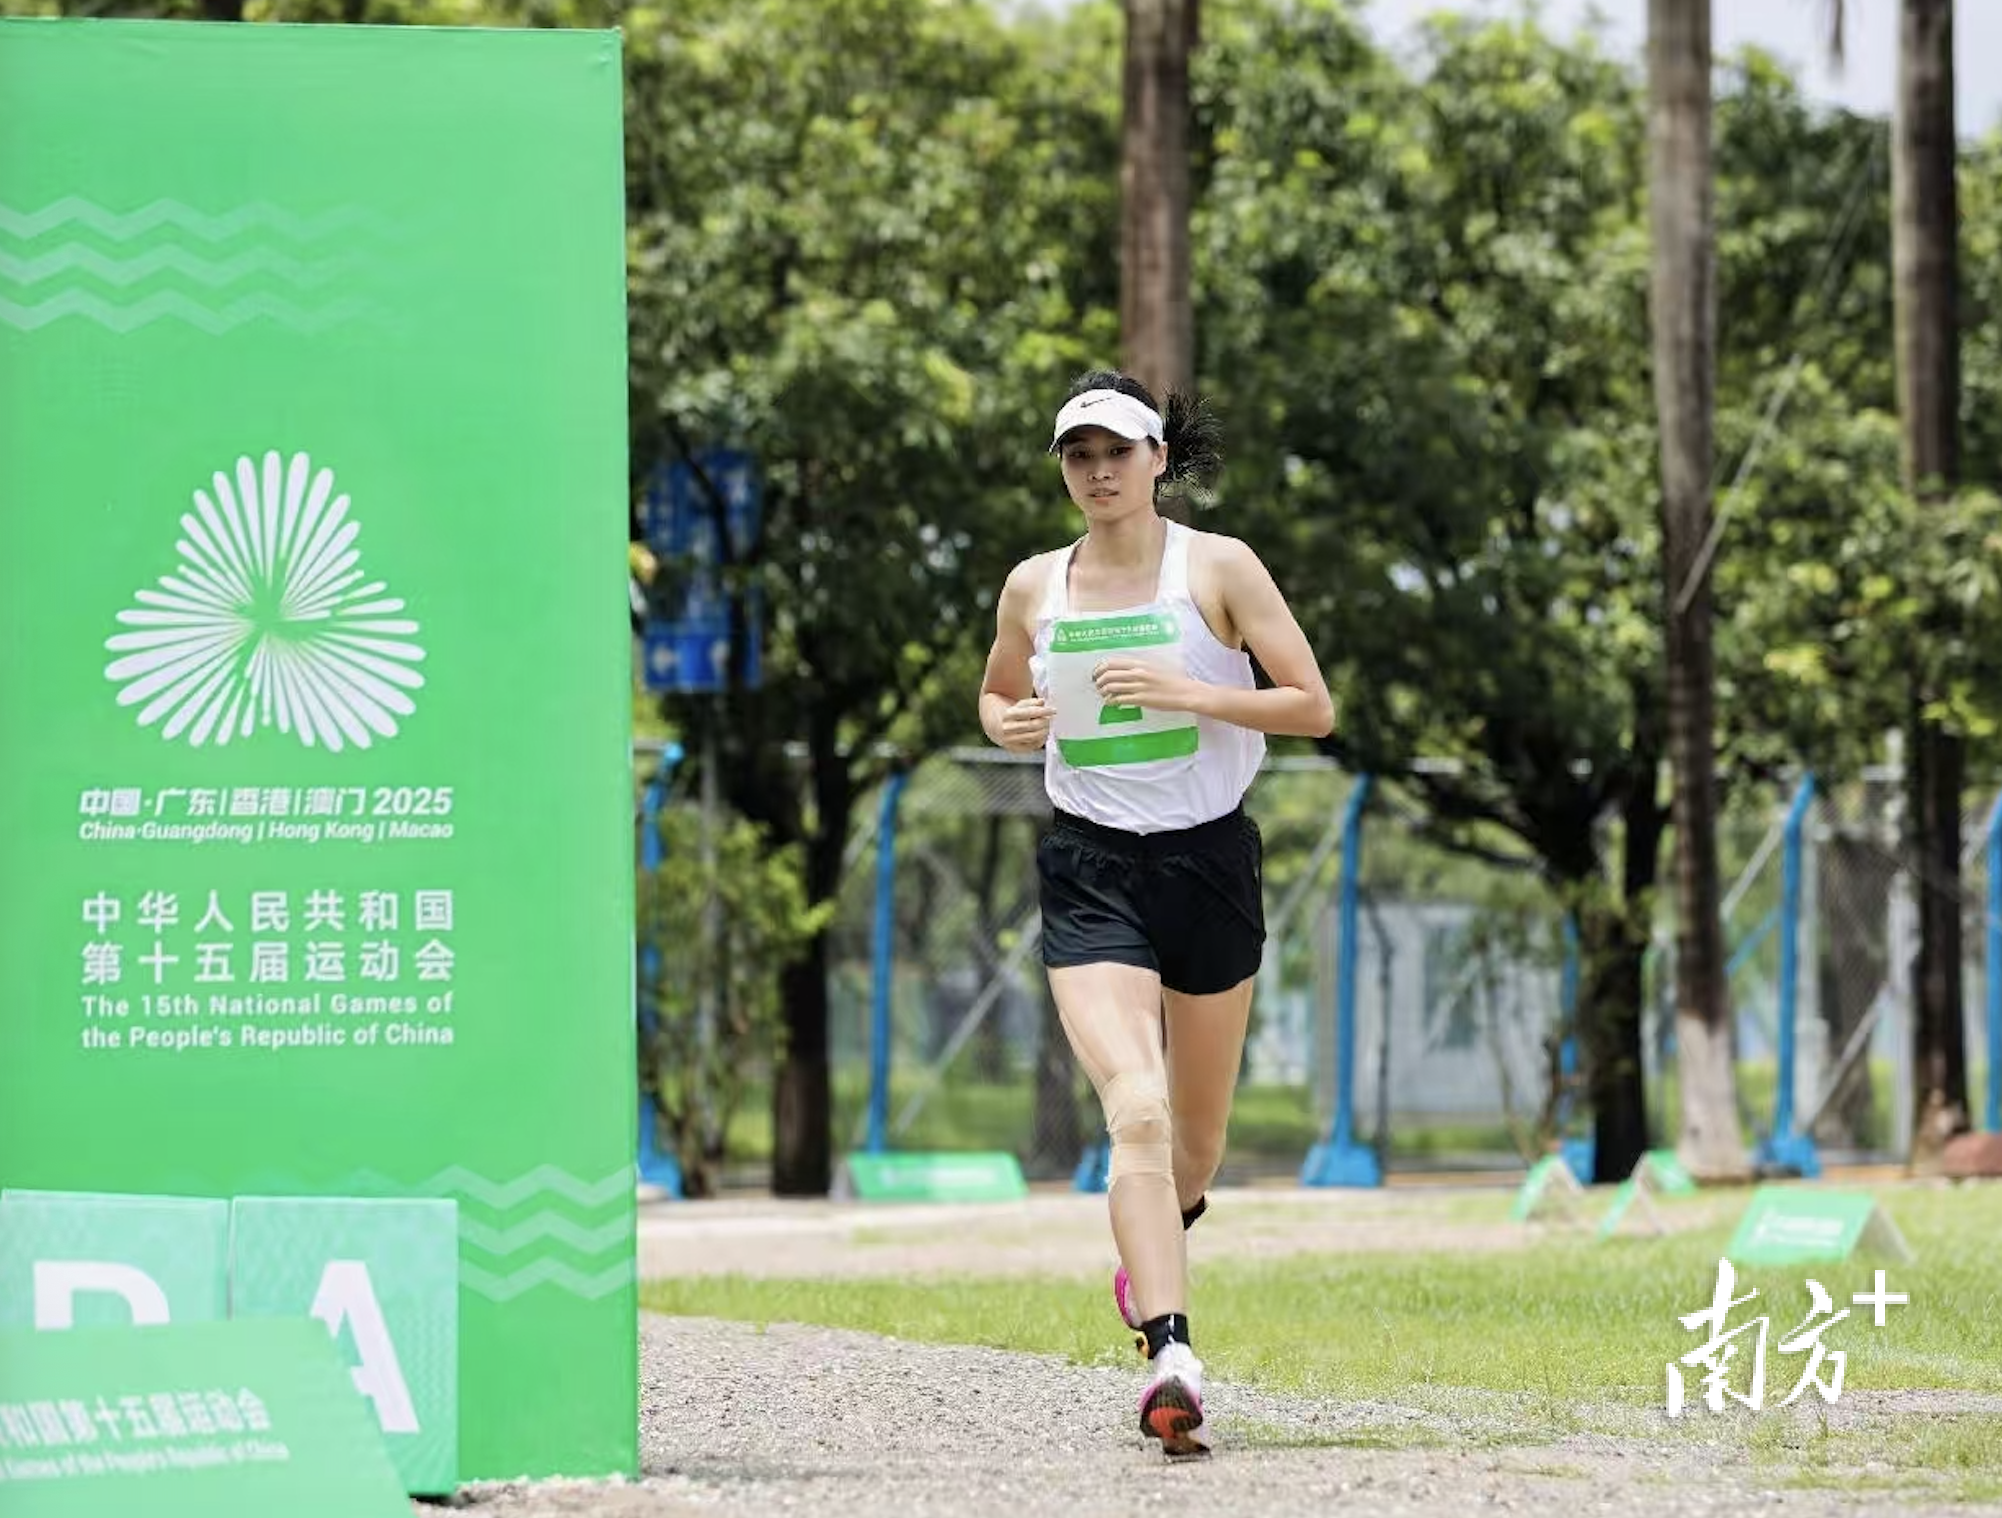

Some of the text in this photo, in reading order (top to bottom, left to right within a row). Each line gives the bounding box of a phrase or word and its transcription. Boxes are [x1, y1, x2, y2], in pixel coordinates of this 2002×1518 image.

[372, 787, 453, 816] 2025
[268, 822, 320, 843] Hong
[325, 822, 375, 843] Kong
[389, 821, 454, 840] Macao
[82, 889, 454, 935] 中华人民共和国
[81, 938, 455, 985] 第十五届运动会
[82, 990, 453, 1016] The 15th National Games of
[82, 1023, 454, 1051] the People's Republic of China
[309, 1259, 420, 1433] A
[0, 1386, 271, 1448] 和国第十五届运动会
